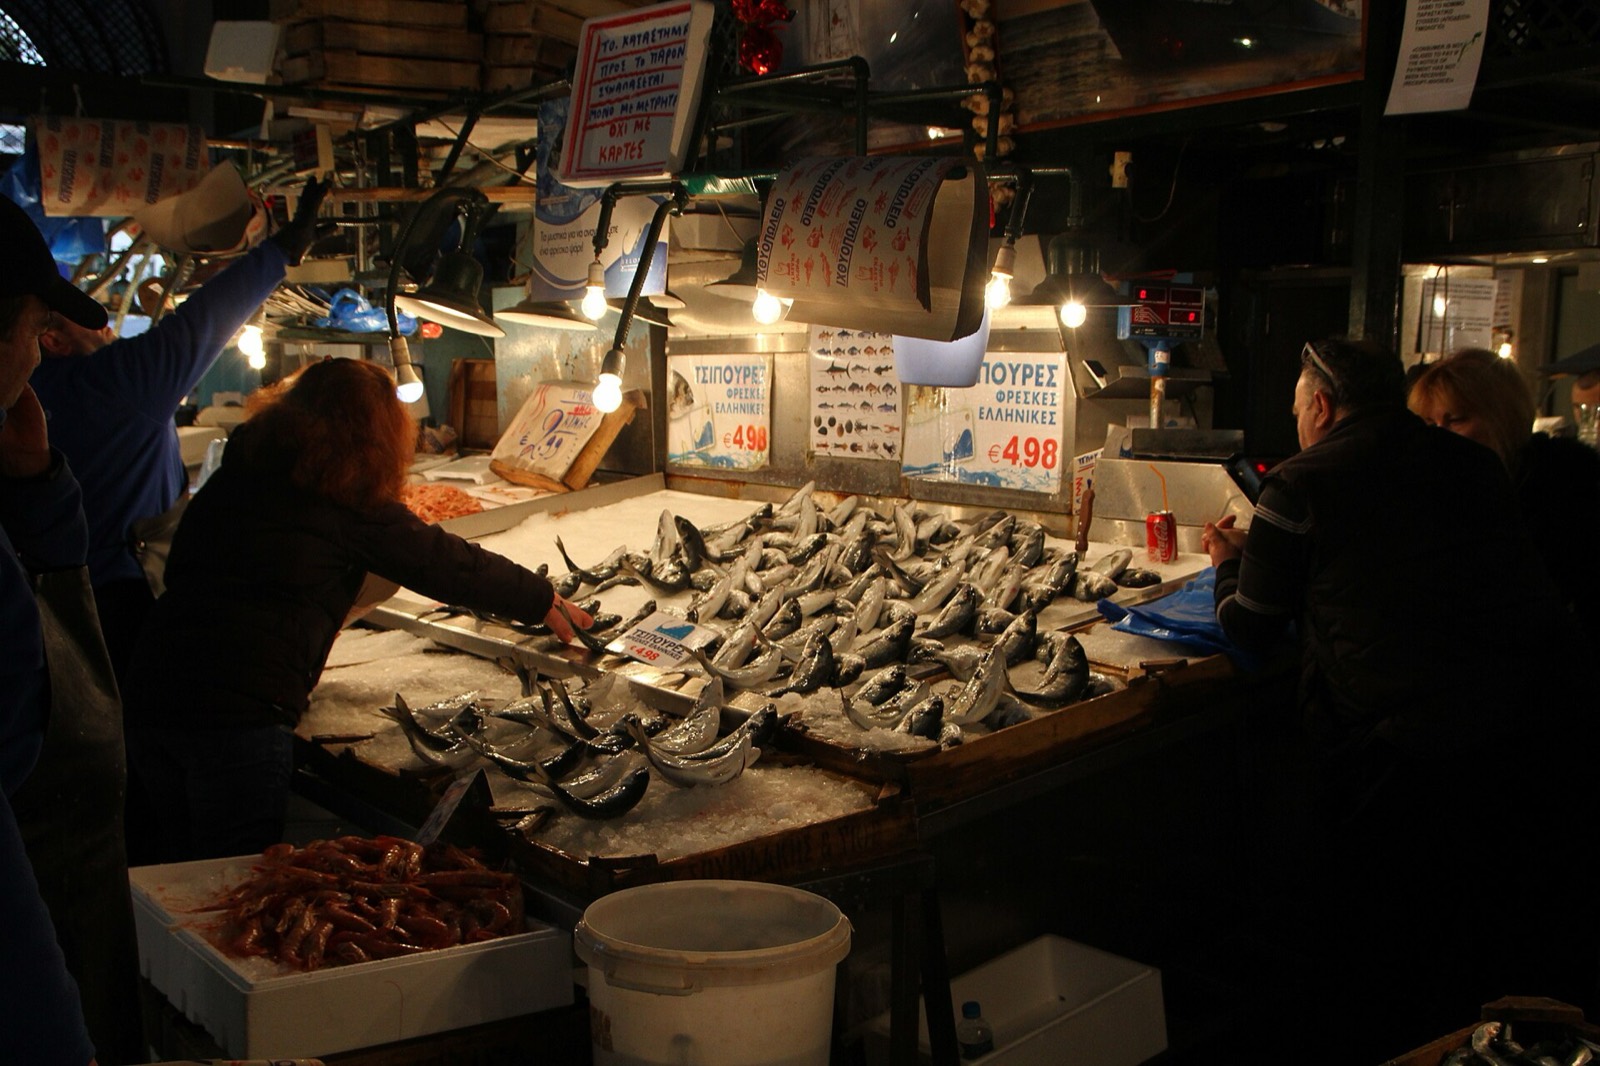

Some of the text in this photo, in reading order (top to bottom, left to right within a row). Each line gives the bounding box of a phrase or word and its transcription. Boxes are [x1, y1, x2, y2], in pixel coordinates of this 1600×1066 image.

[601, 44, 686, 78] ΠΡΟΣ ΤΟ ΠΑΡΟΝ
[588, 106, 614, 120] ΜΟΝΟ
[609, 122, 628, 138] ΟΧΙ
[598, 139, 646, 164] ΚΑΡΤΕΣ
[756, 198, 785, 281] ΙΧΘΥΟΠΩΛΕΙΟ
[836, 198, 866, 287] ΙΧΘΥΟΠΩΛΕΙΟ
[695, 365, 766, 384] ΤΣΙΠΟΥΡΕΣ
[977, 362, 1059, 388] ΠΟΥΡΕΣ
[726, 388, 765, 400] ΦΡΕΣΚΕΣ
[996, 389, 1057, 406] ΦΡΕΣΚΕΣ
[716, 402, 765, 415] ΕΛΛΗΝΙΚΕΣ
[979, 406, 1056, 425] ΕΛΛΗΝΙΚΕΣ
[632, 629, 685, 655] ΤΣΙΠΟΥΡΕΣ
